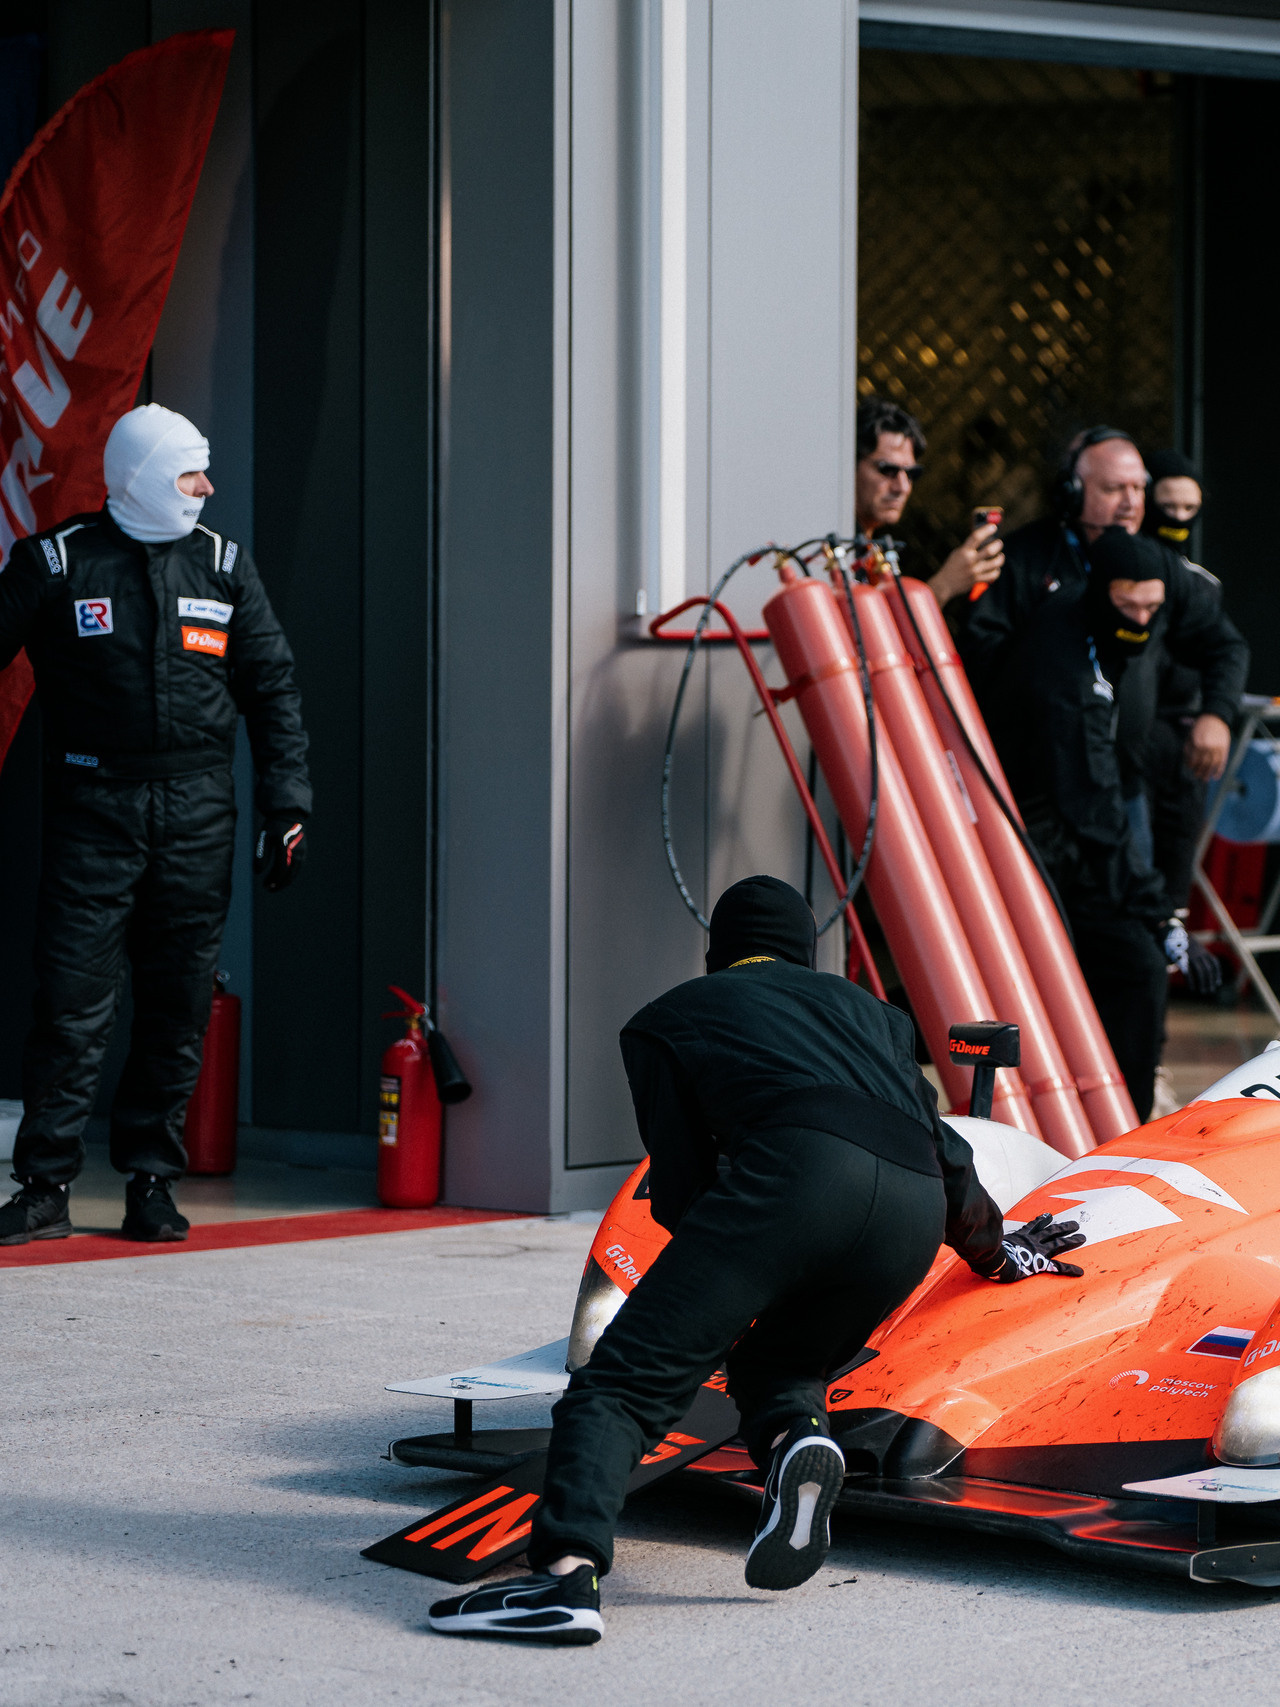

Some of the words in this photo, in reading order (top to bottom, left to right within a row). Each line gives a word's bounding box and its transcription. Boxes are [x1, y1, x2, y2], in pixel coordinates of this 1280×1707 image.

[949, 1038, 991, 1056] G-DRIVE
[1160, 1377, 1218, 1390] moscow
[1149, 1384, 1209, 1398] polytech
